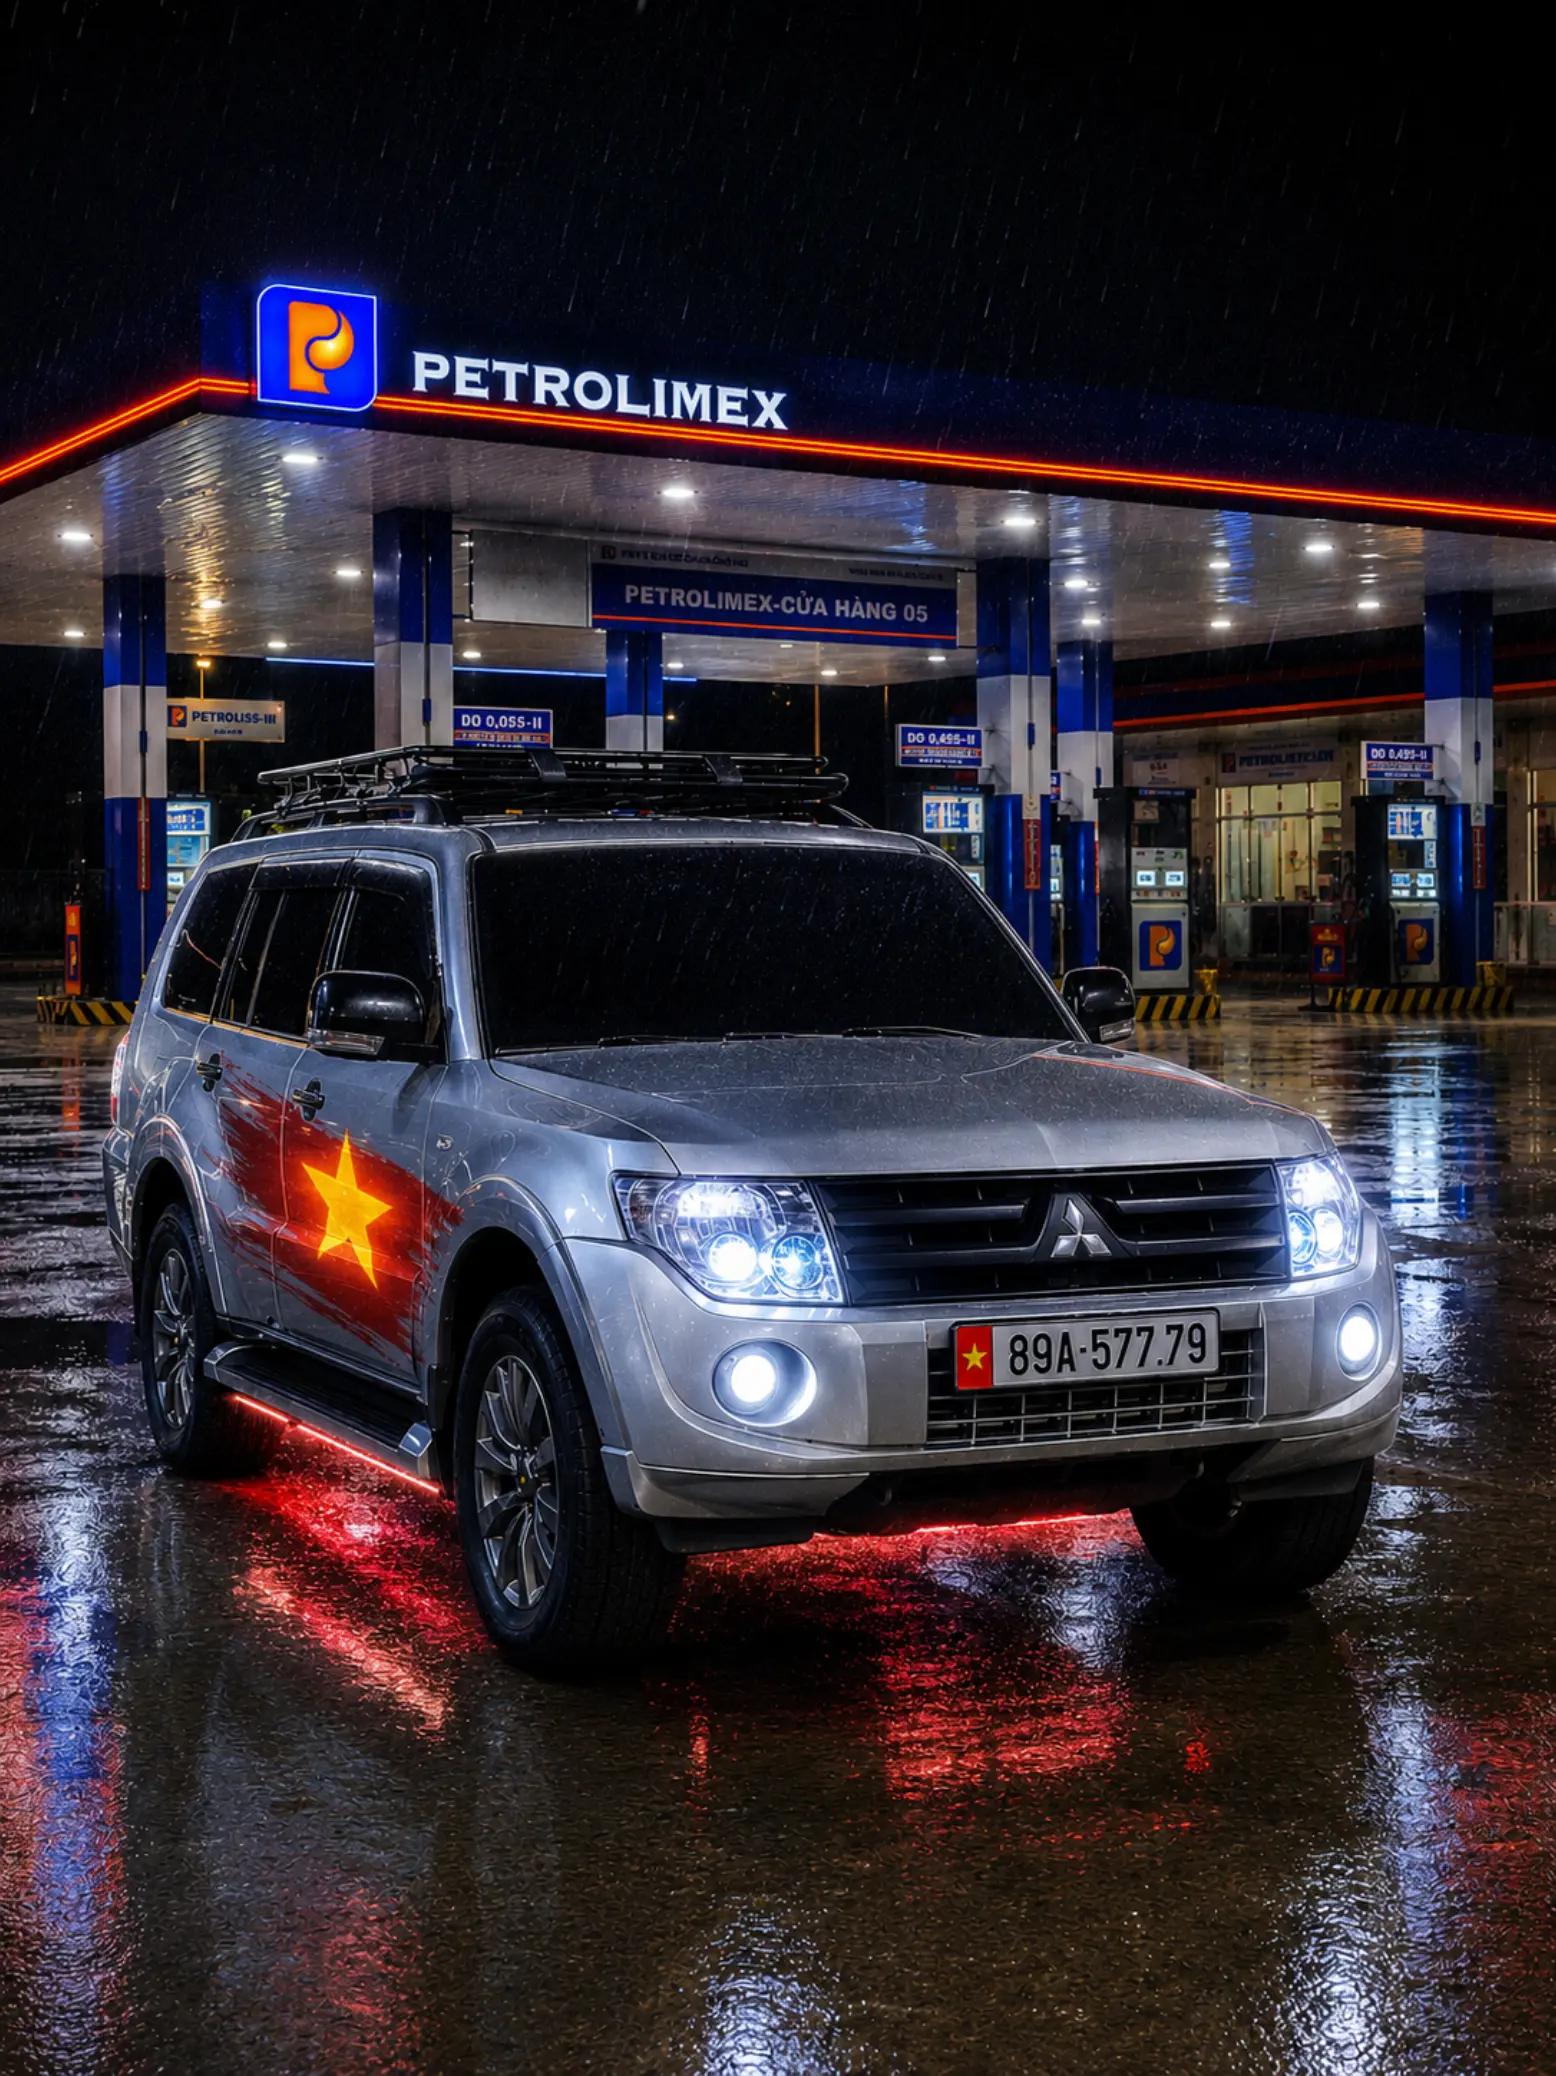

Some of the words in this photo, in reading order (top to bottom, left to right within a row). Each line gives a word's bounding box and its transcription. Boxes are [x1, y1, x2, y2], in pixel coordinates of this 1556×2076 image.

[412, 351, 788, 430] PETROLIMEX
[624, 583, 829, 617] PETROLIMEX-CỬA
[835, 595, 897, 621] HÀNG
[903, 603, 928, 623] 05
[461, 714, 481, 727] DO
[907, 732, 925, 743] DO
[1009, 1322, 1207, 1376] 89A-577.79
